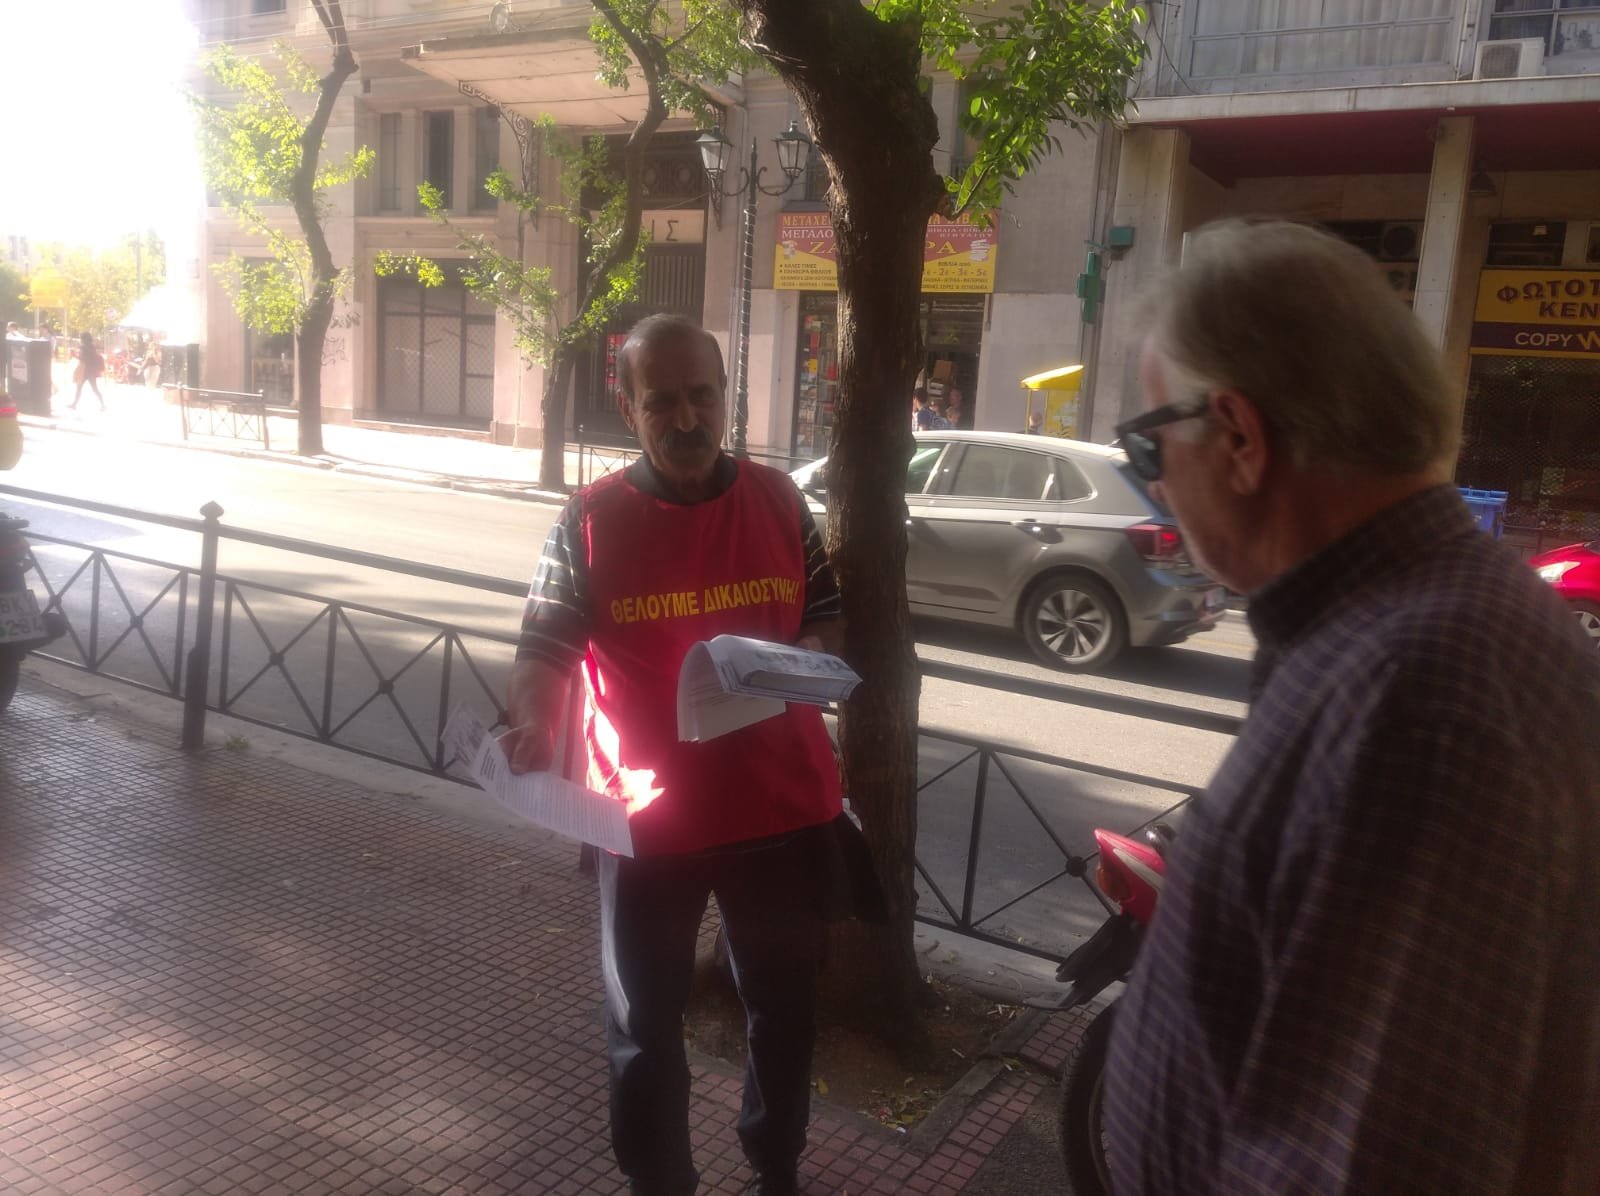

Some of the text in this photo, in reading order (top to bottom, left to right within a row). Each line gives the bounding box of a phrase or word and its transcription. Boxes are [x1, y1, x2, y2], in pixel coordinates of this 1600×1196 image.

[782, 215, 831, 226] ΜΕΤΑΧΕΙ
[781, 229, 834, 239] ΜΕΓΑΛΟ
[1515, 332, 1573, 347] COPY
[610, 576, 800, 624] ΘΕΛΟΥΜΕ ΔΙΚΑΙΟΣΥΝΗ!
